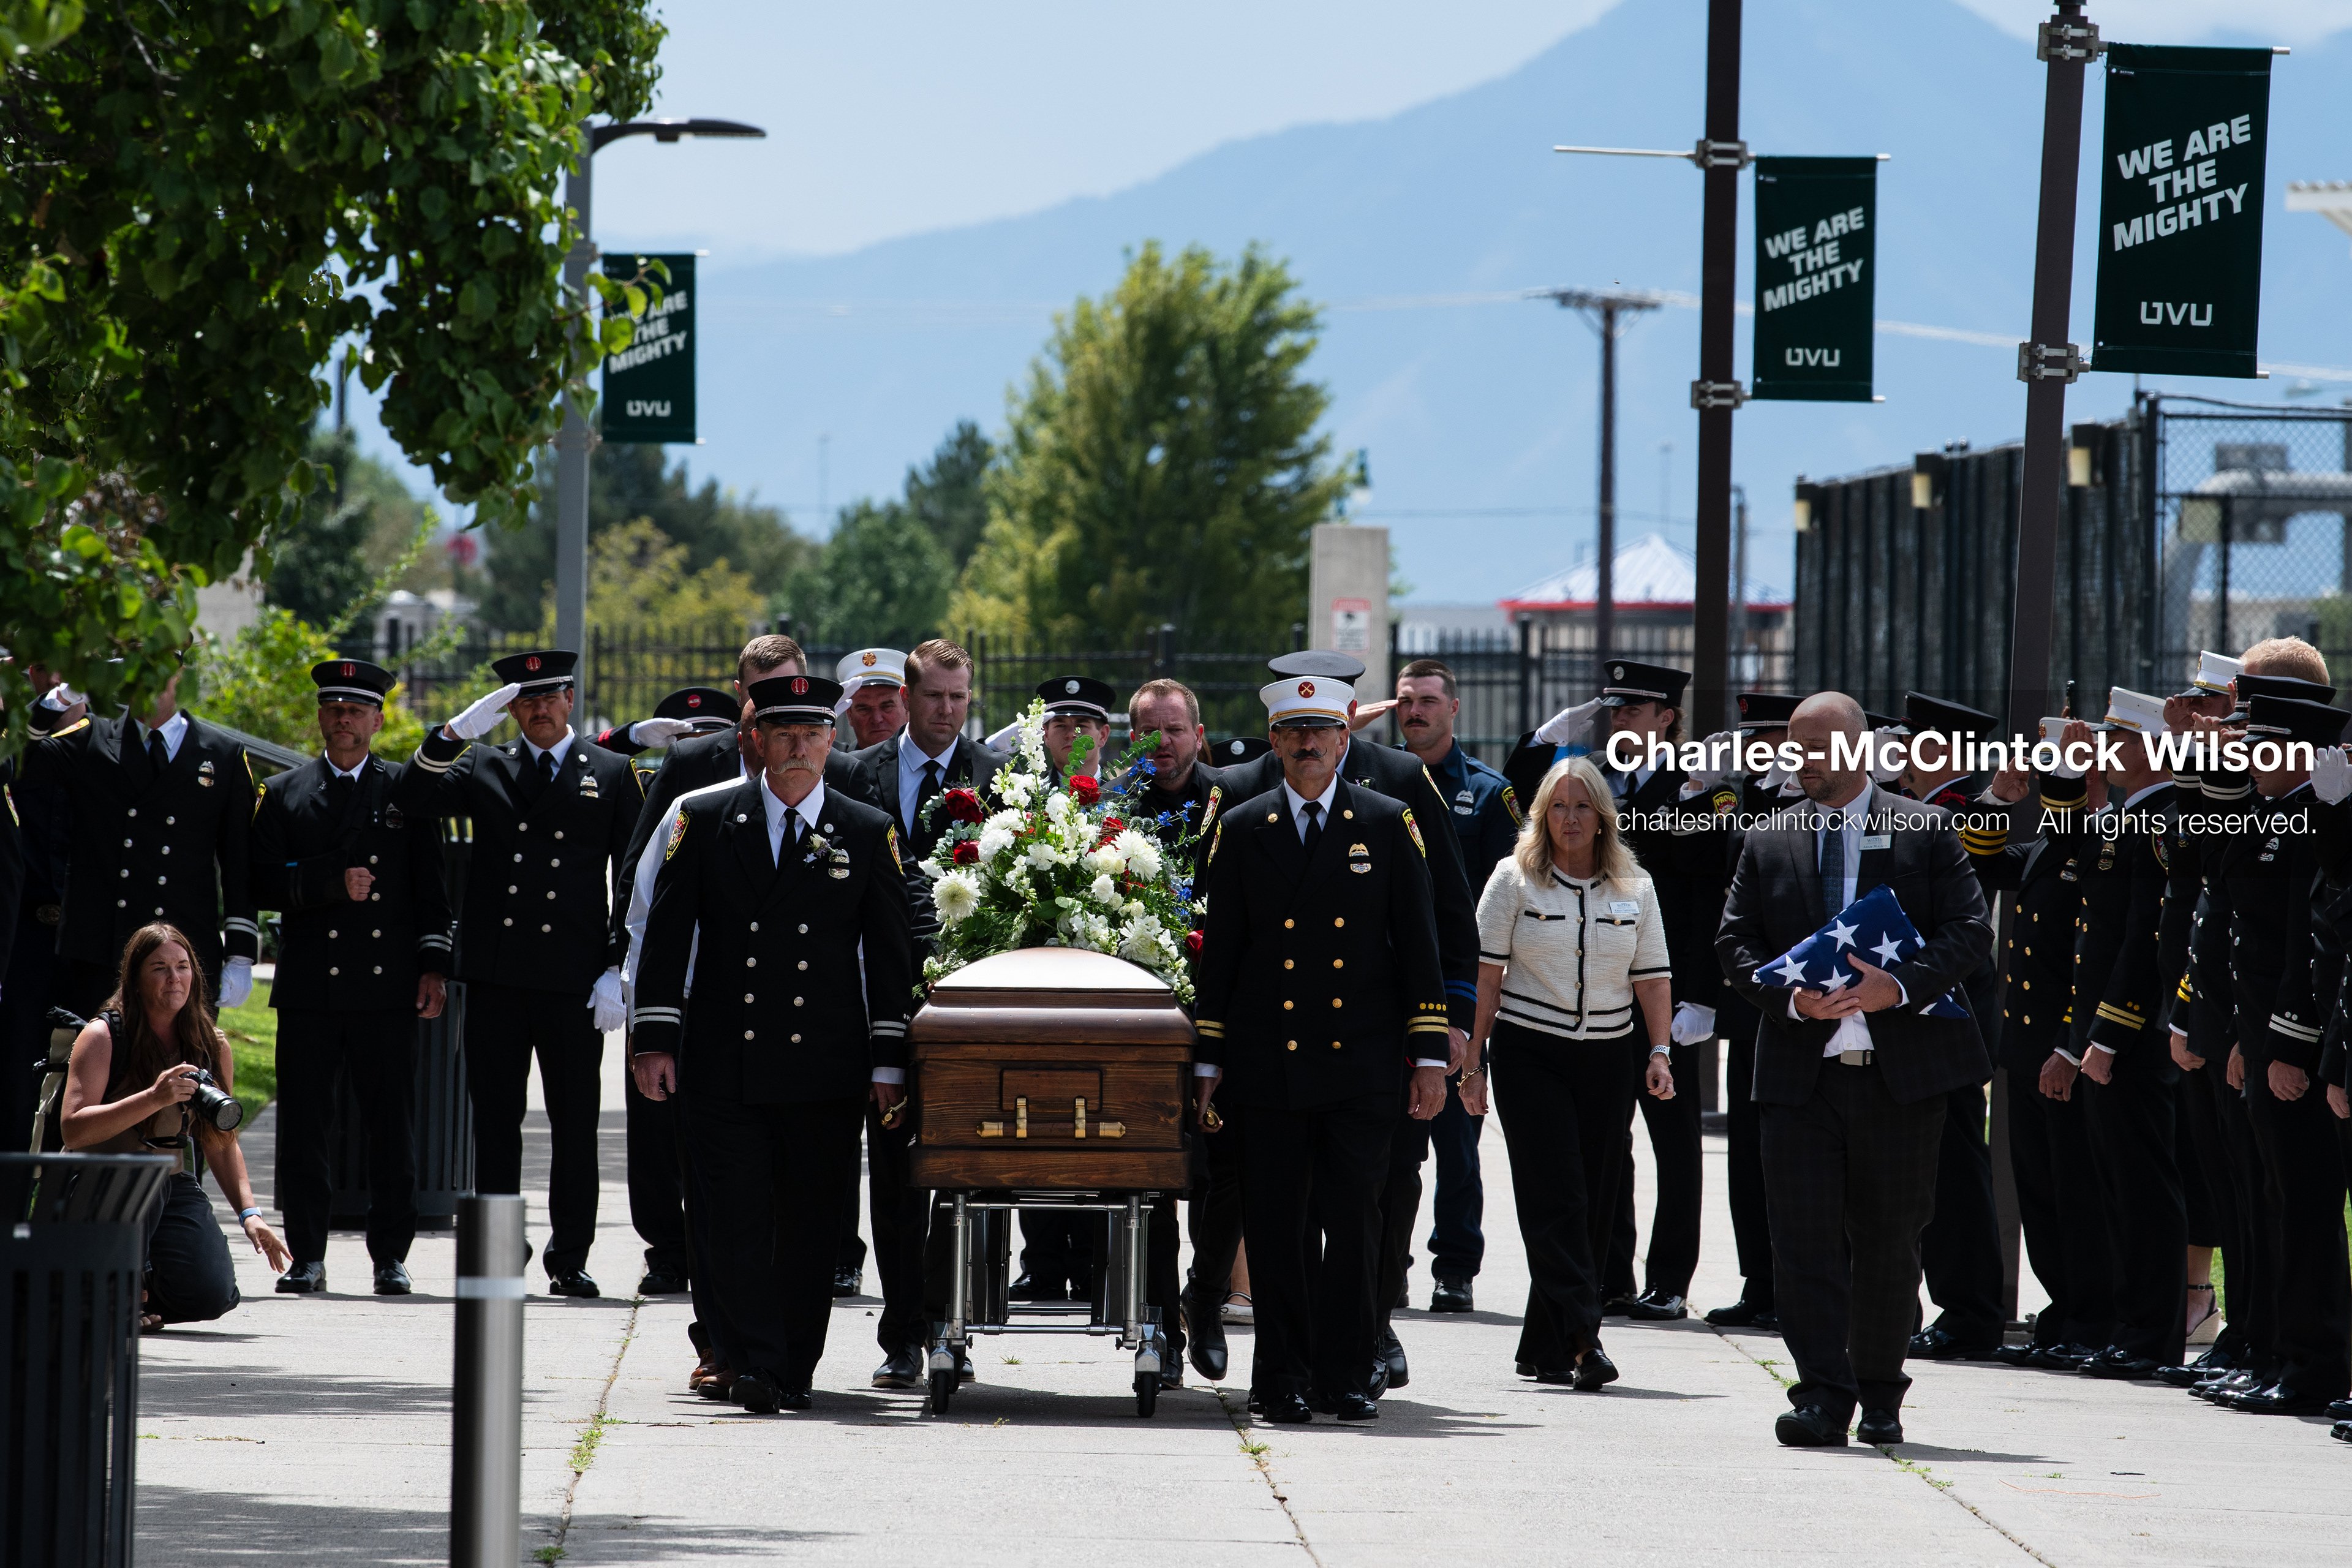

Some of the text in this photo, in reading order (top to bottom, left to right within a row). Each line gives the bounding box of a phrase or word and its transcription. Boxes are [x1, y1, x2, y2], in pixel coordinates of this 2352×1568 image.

[2116, 114, 2252, 180] WE ARE
[2148, 159, 2217, 204] THE
[1764, 207, 1865, 259] WE ARE
[2113, 183, 2248, 252] MIGHTY
[1788, 240, 1841, 277] THE
[1763, 258, 1864, 312] MIGHTY
[2140, 301, 2213, 326] UVU
[608, 330, 688, 374] MIGHTY
[1785, 347, 1841, 368] UVU
[626, 399, 672, 418] UVU
[1716, 794, 1735, 806] PROVO
